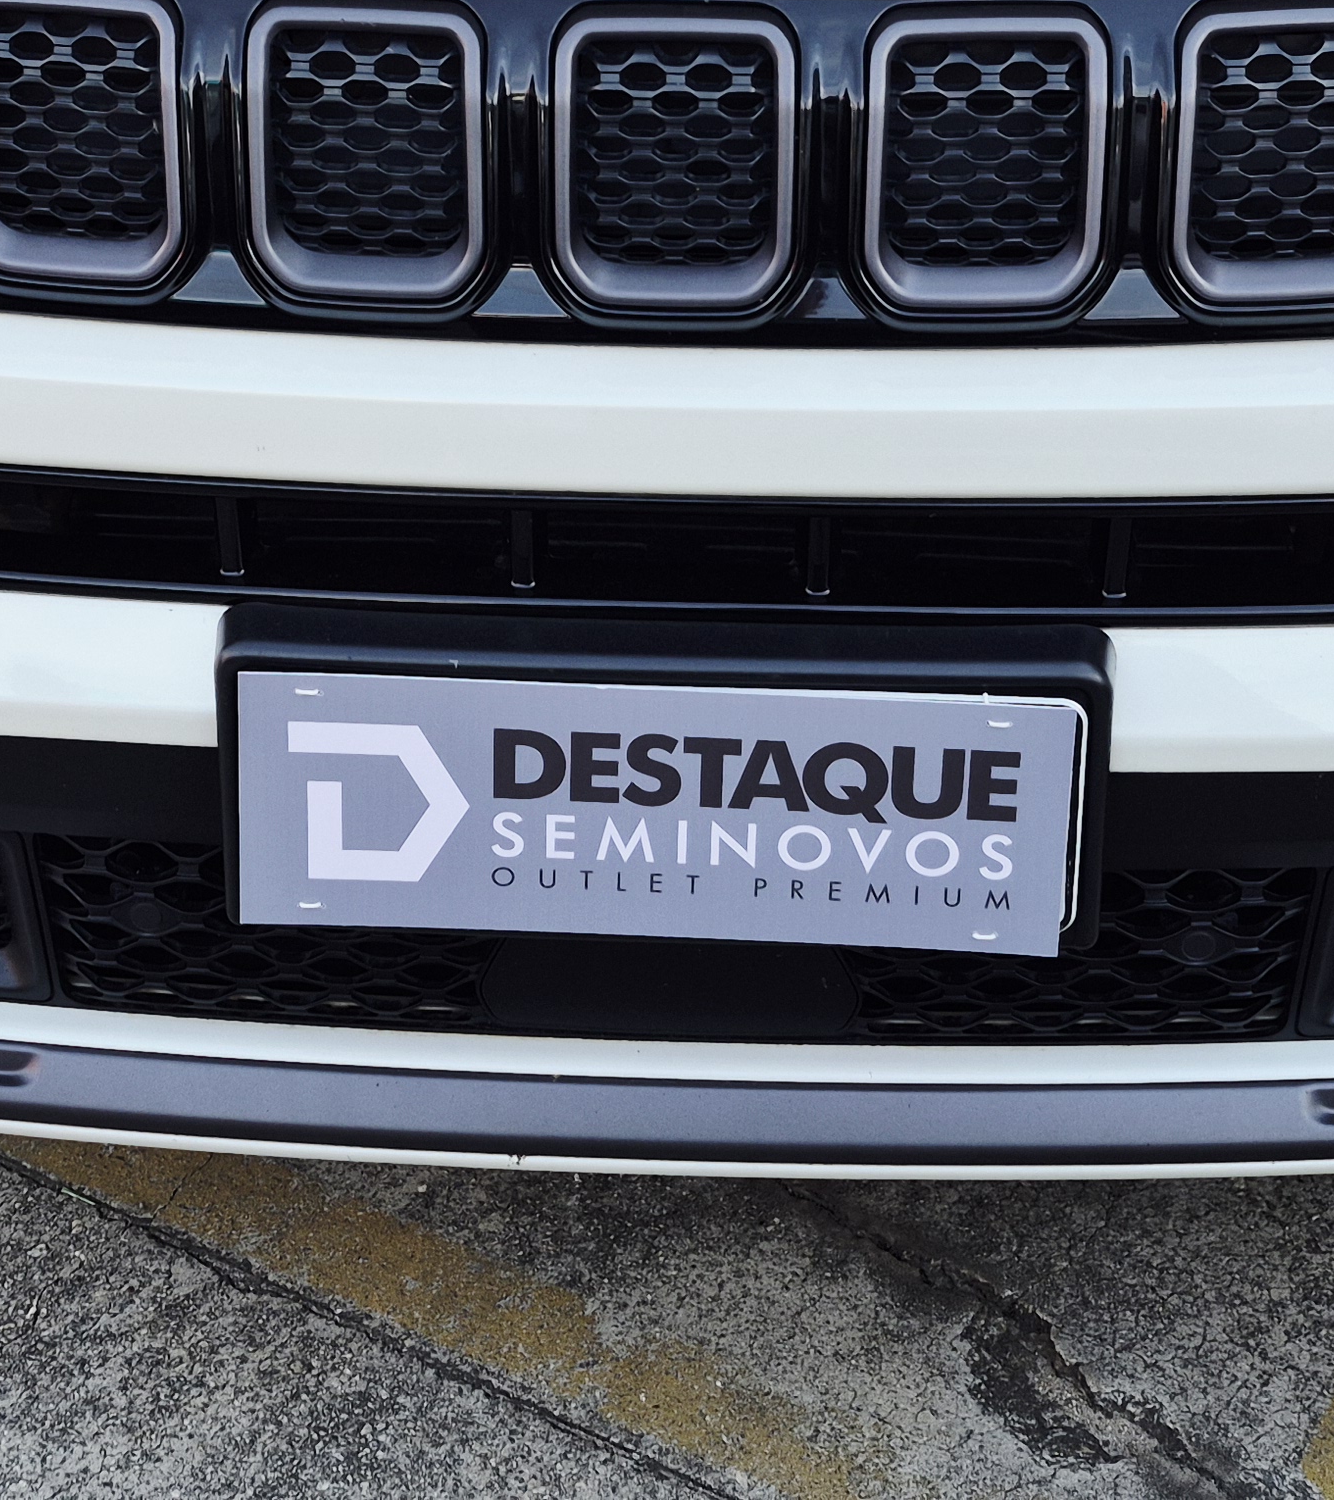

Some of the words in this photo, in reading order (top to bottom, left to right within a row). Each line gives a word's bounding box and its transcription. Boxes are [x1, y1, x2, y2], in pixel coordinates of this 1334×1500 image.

[492, 727, 1022, 823] DESTAQUE
[492, 811, 1014, 881] SEMINOVOS
[492, 866, 701, 896] OUTLET
[754, 877, 1011, 911] PREMIUM
